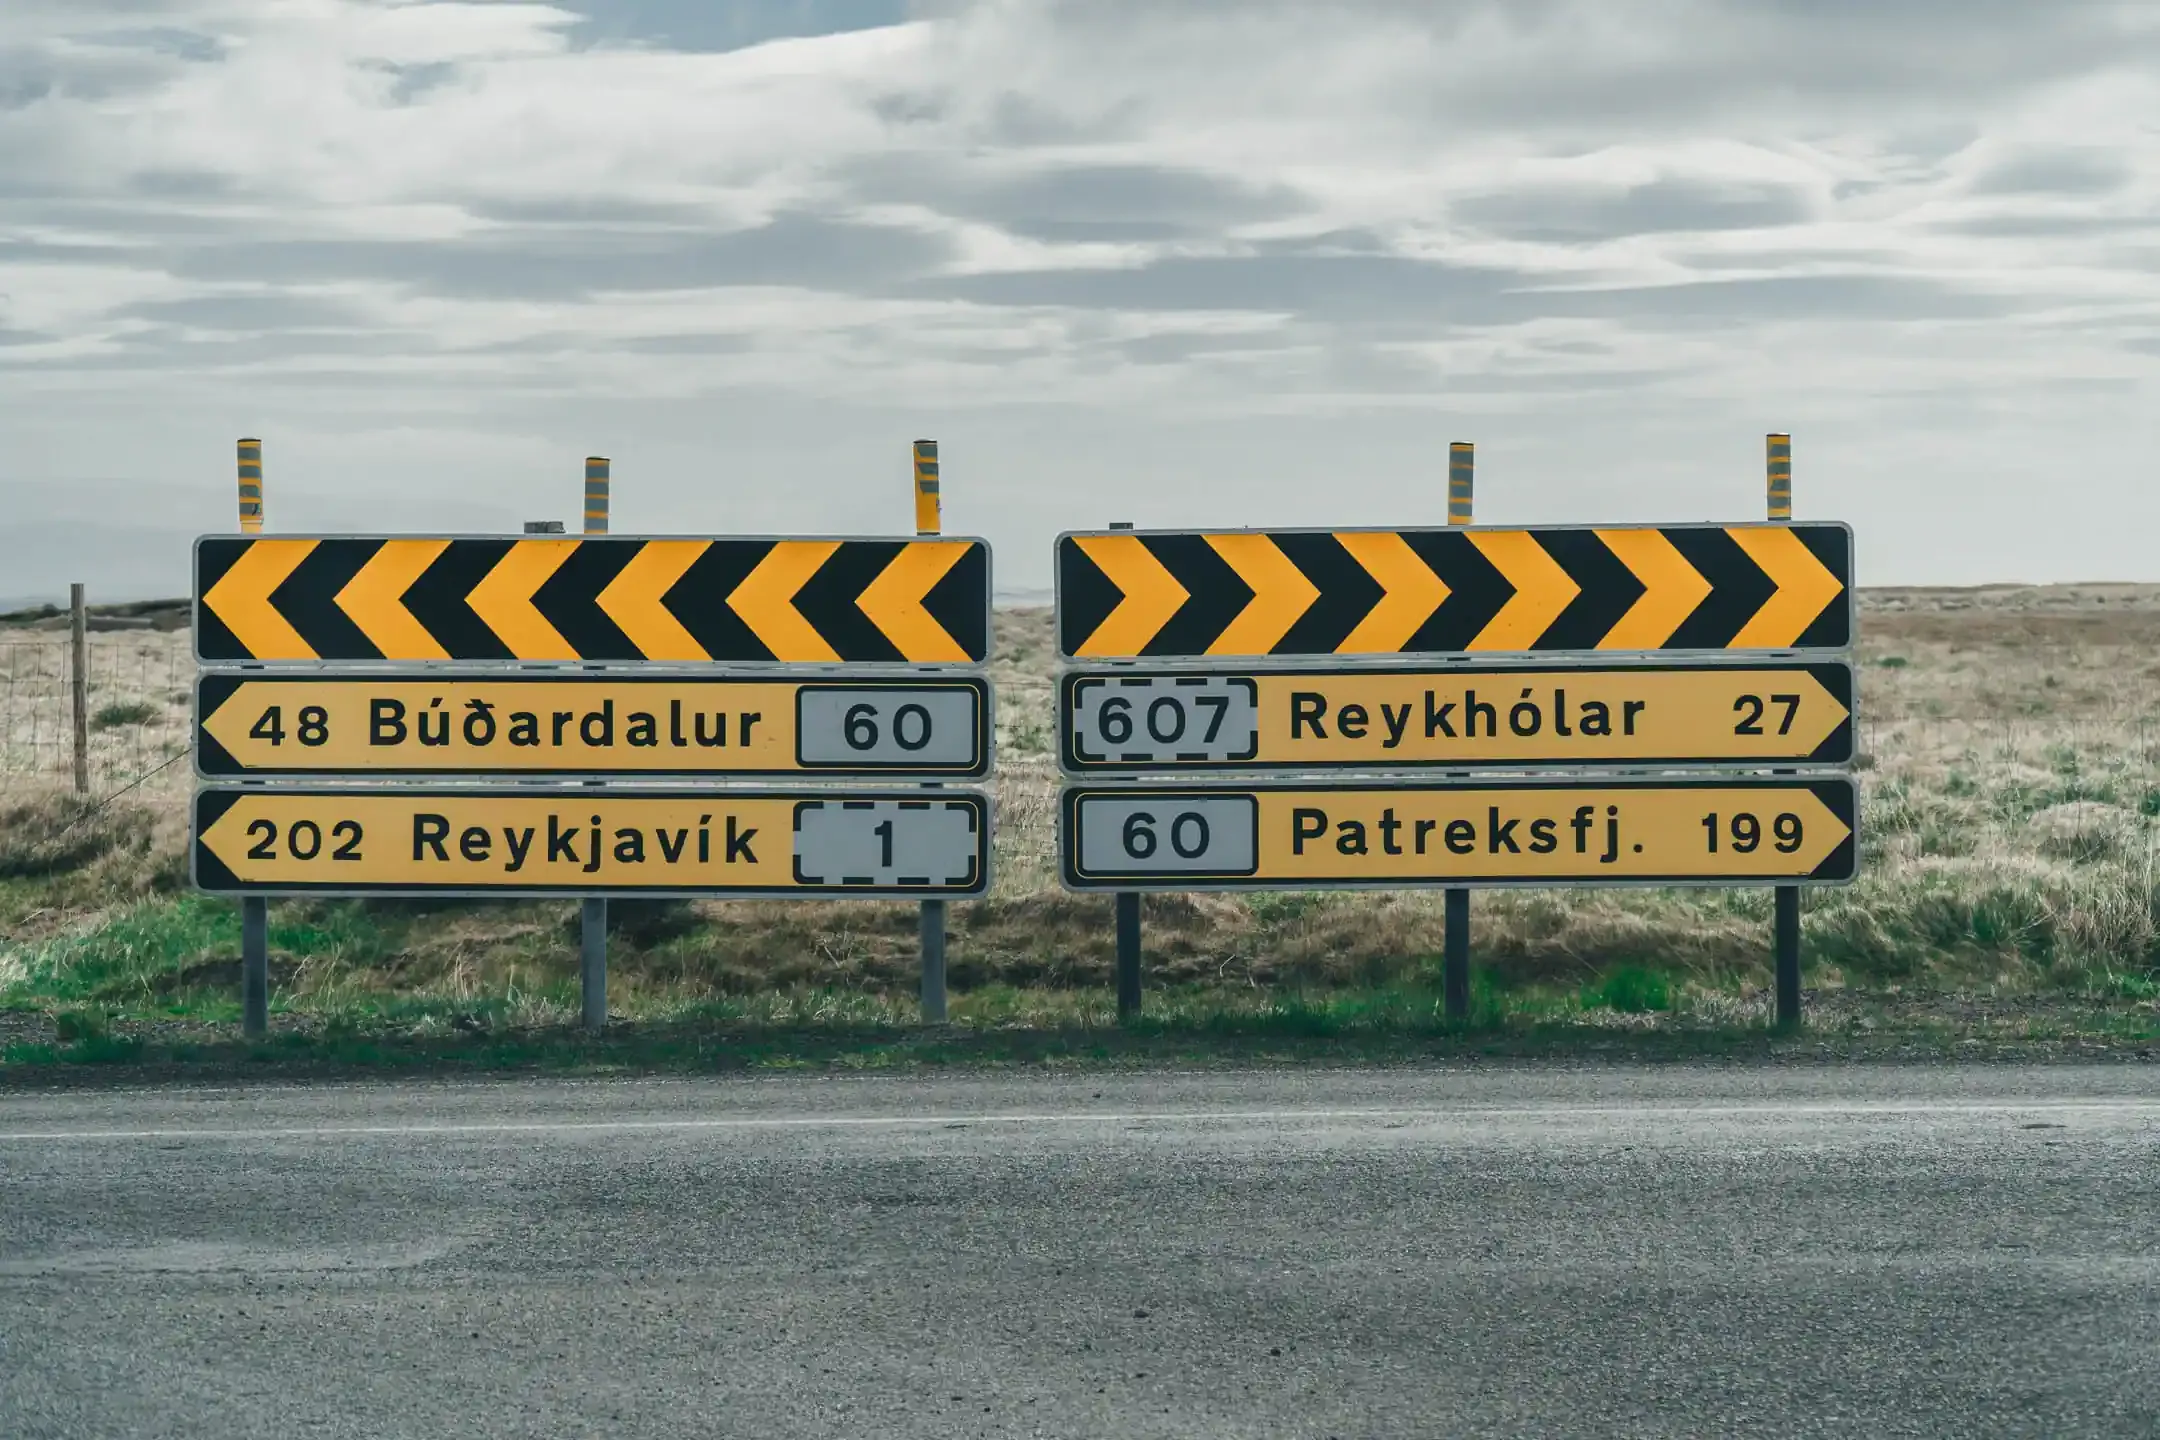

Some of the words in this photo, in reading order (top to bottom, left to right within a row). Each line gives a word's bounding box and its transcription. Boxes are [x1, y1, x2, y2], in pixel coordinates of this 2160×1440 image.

[248, 705, 329, 747] 48
[369, 697, 762, 748] Búðardalur
[843, 703, 933, 751] 60
[1097, 695, 1230, 745] 607
[1290, 687, 1646, 749] Reykhólar
[1732, 694, 1801, 736] 27
[246, 818, 364, 861] 202
[412, 813, 759, 874] Reykjavík
[873, 819, 893, 868] 1
[1122, 811, 1211, 860] 60
[1292, 804, 1644, 864] Patreksfj.
[1701, 812, 1804, 854] 199
